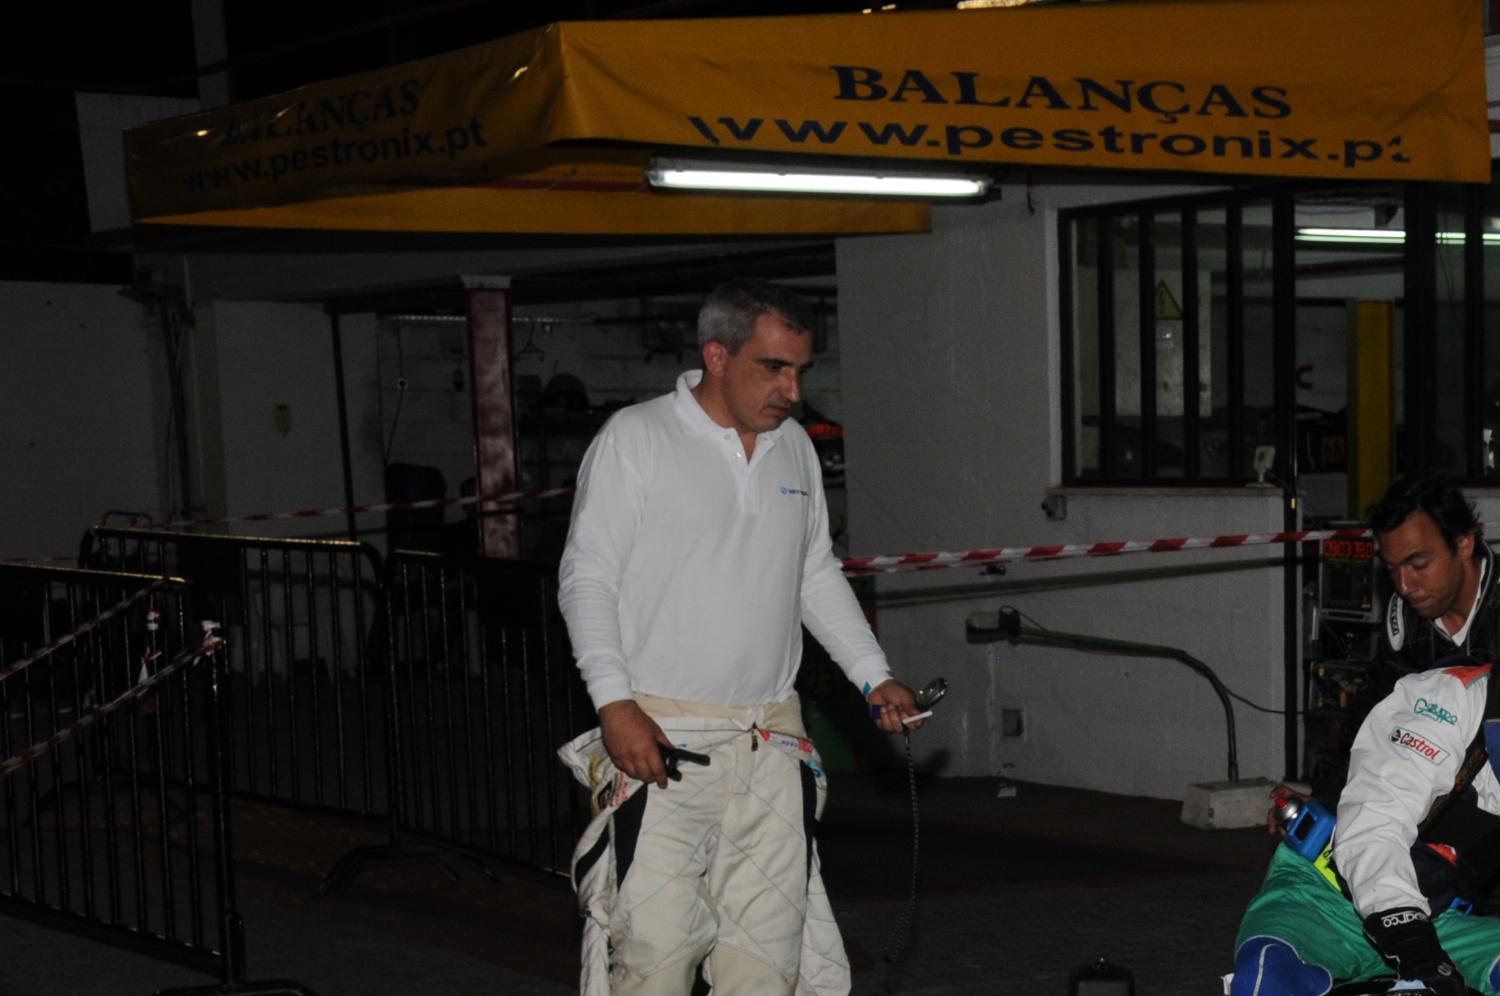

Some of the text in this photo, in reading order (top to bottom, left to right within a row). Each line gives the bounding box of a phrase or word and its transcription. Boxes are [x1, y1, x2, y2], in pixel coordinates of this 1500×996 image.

[829, 65, 1291, 124] BALANÇAS
[183, 117, 486, 193] www.pestronix.pt
[1400, 732, 1441, 760] Castrol
[1380, 909, 1429, 928] arco
